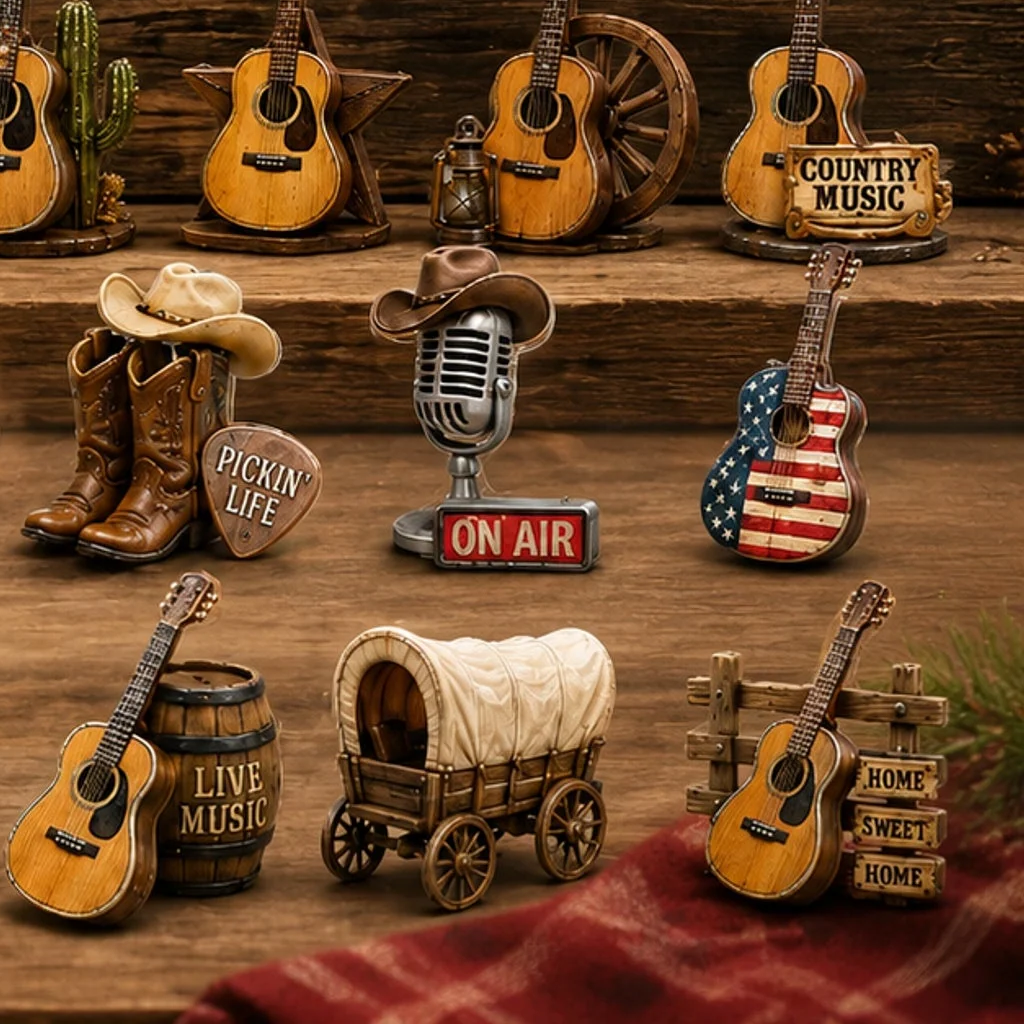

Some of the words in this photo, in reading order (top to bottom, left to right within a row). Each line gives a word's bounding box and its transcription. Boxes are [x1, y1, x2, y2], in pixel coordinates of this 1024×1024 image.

[800, 157, 921, 182] COUNTRY
[813, 184, 905, 211] MUSIC
[215, 445, 312, 499] PICKIN'
[225, 485, 280, 527] LIFE
[451, 519, 501, 556] ON
[513, 520, 575, 557] AIR
[194, 761, 263, 798] LIVE
[868, 768, 925, 791] HOME
[180, 797, 268, 834] MUSIC
[862, 816, 926, 841] SWEET
[865, 864, 922, 888] HOME
